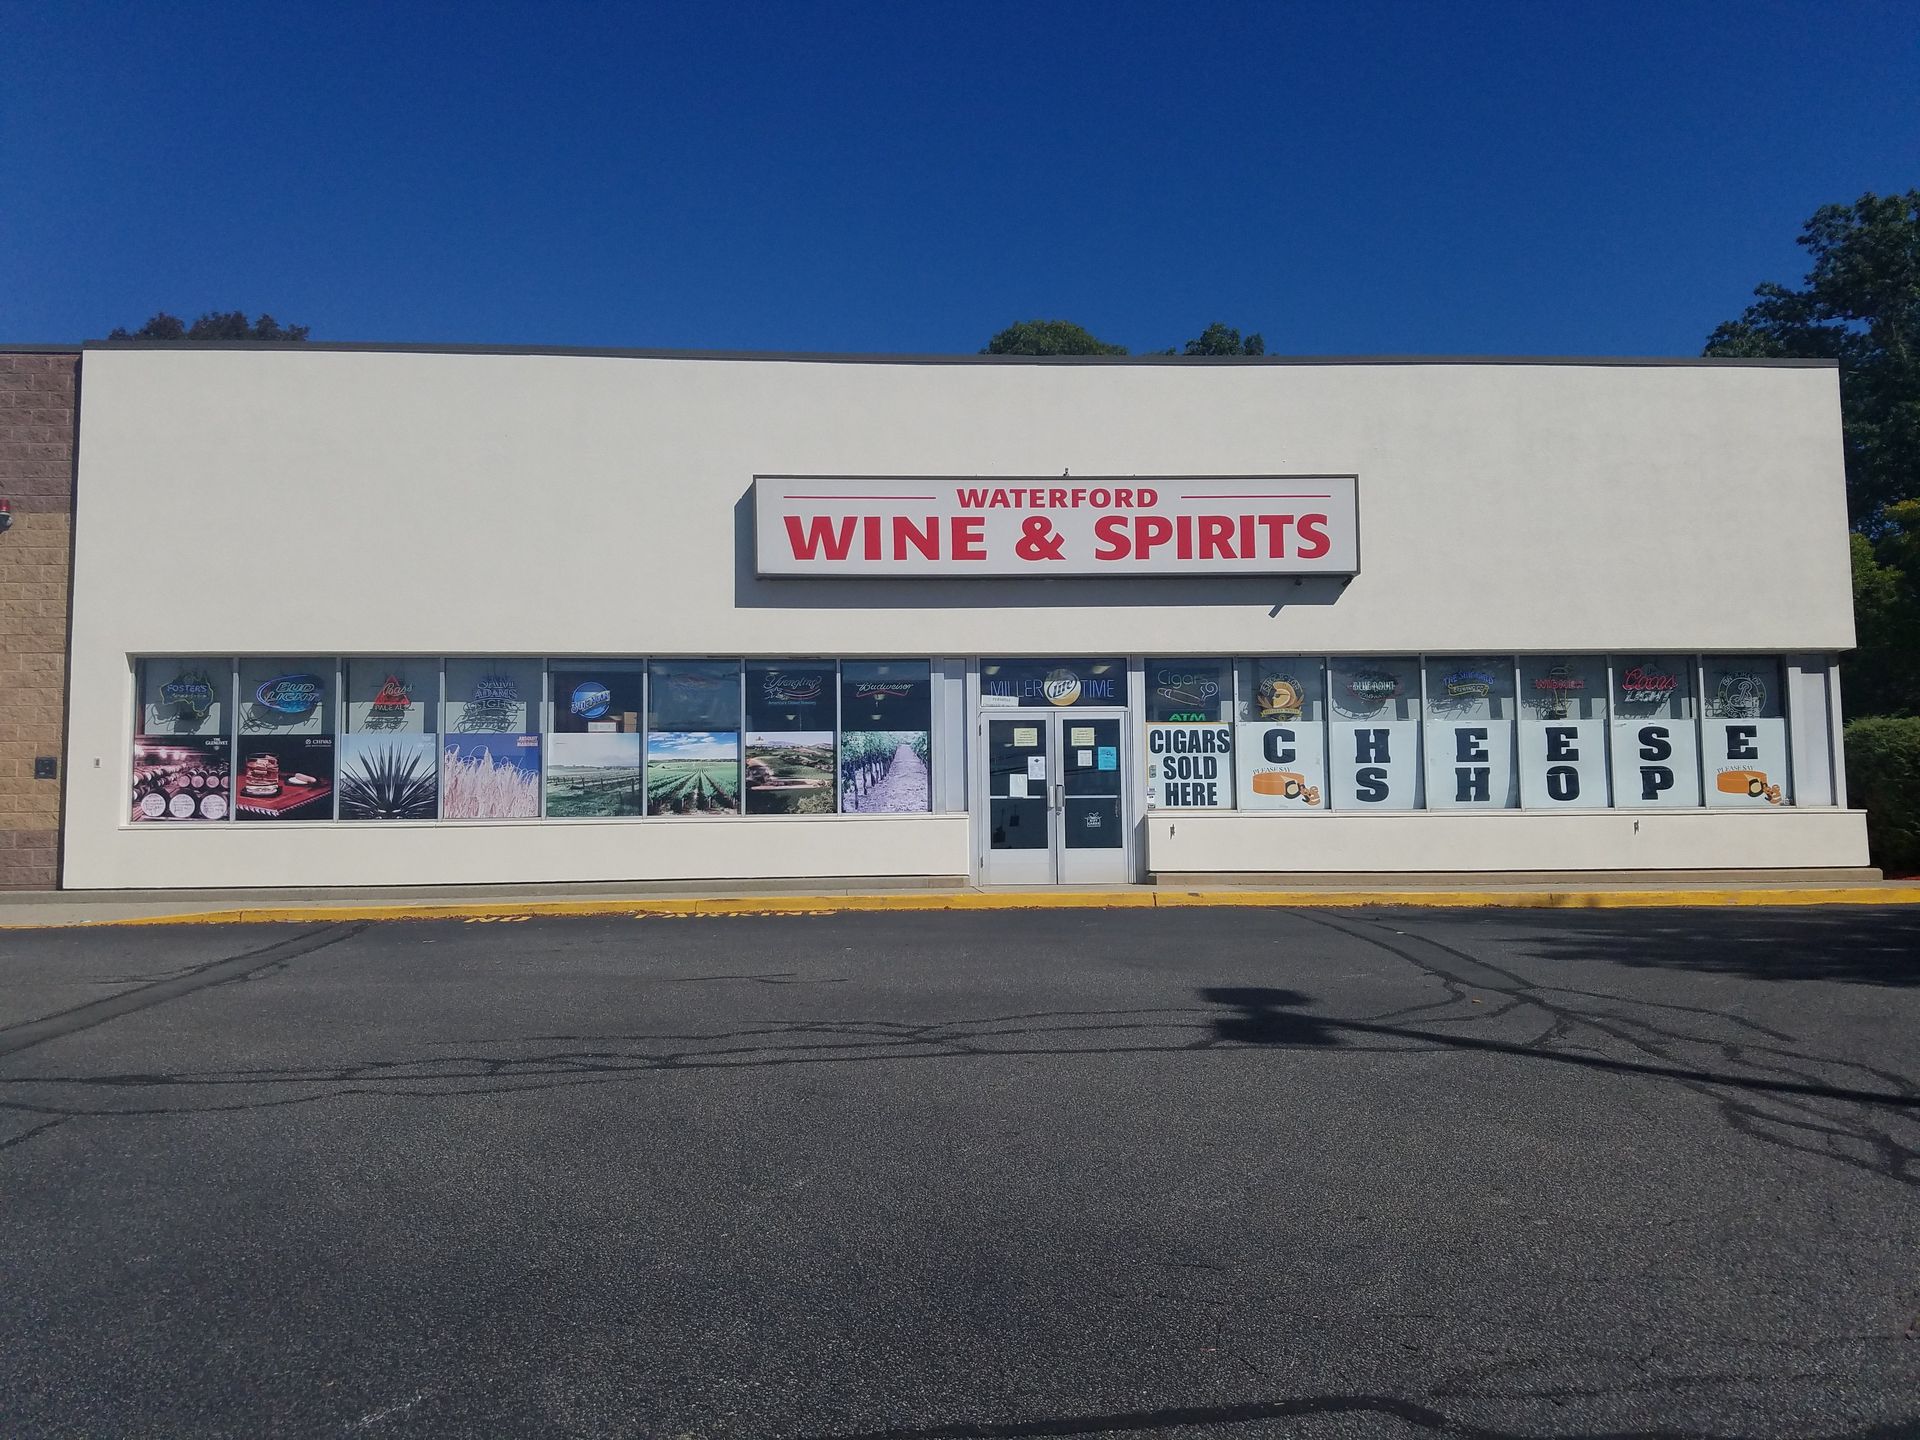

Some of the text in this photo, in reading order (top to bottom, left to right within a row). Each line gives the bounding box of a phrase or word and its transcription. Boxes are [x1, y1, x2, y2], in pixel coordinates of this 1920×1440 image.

[957, 488, 1158, 508] WATERFORD
[783, 513, 1331, 561] WINE & SPIRITS
[167, 684, 208, 693] FOSTER'S
[275, 681, 315, 692] BUD
[856, 683, 914, 692] Budweiser
[990, 679, 1044, 697] MILLER
[1080, 679, 1115, 698] TIME
[1157, 669, 1208, 689] Cigars
[1622, 668, 1678, 690] Coors
[266, 692, 320, 702] LIGHT
[382, 682, 414, 697] Bass
[474, 688, 518, 700] ADAMS
[1168, 713, 1206, 721] ATM
[1149, 729, 1231, 754] CIGARS
[1263, 725, 1759, 764] C H E E S E
[1163, 756, 1218, 780] SOLD
[1164, 782, 1218, 806] HERE
[1355, 765, 1674, 803] S H O P
